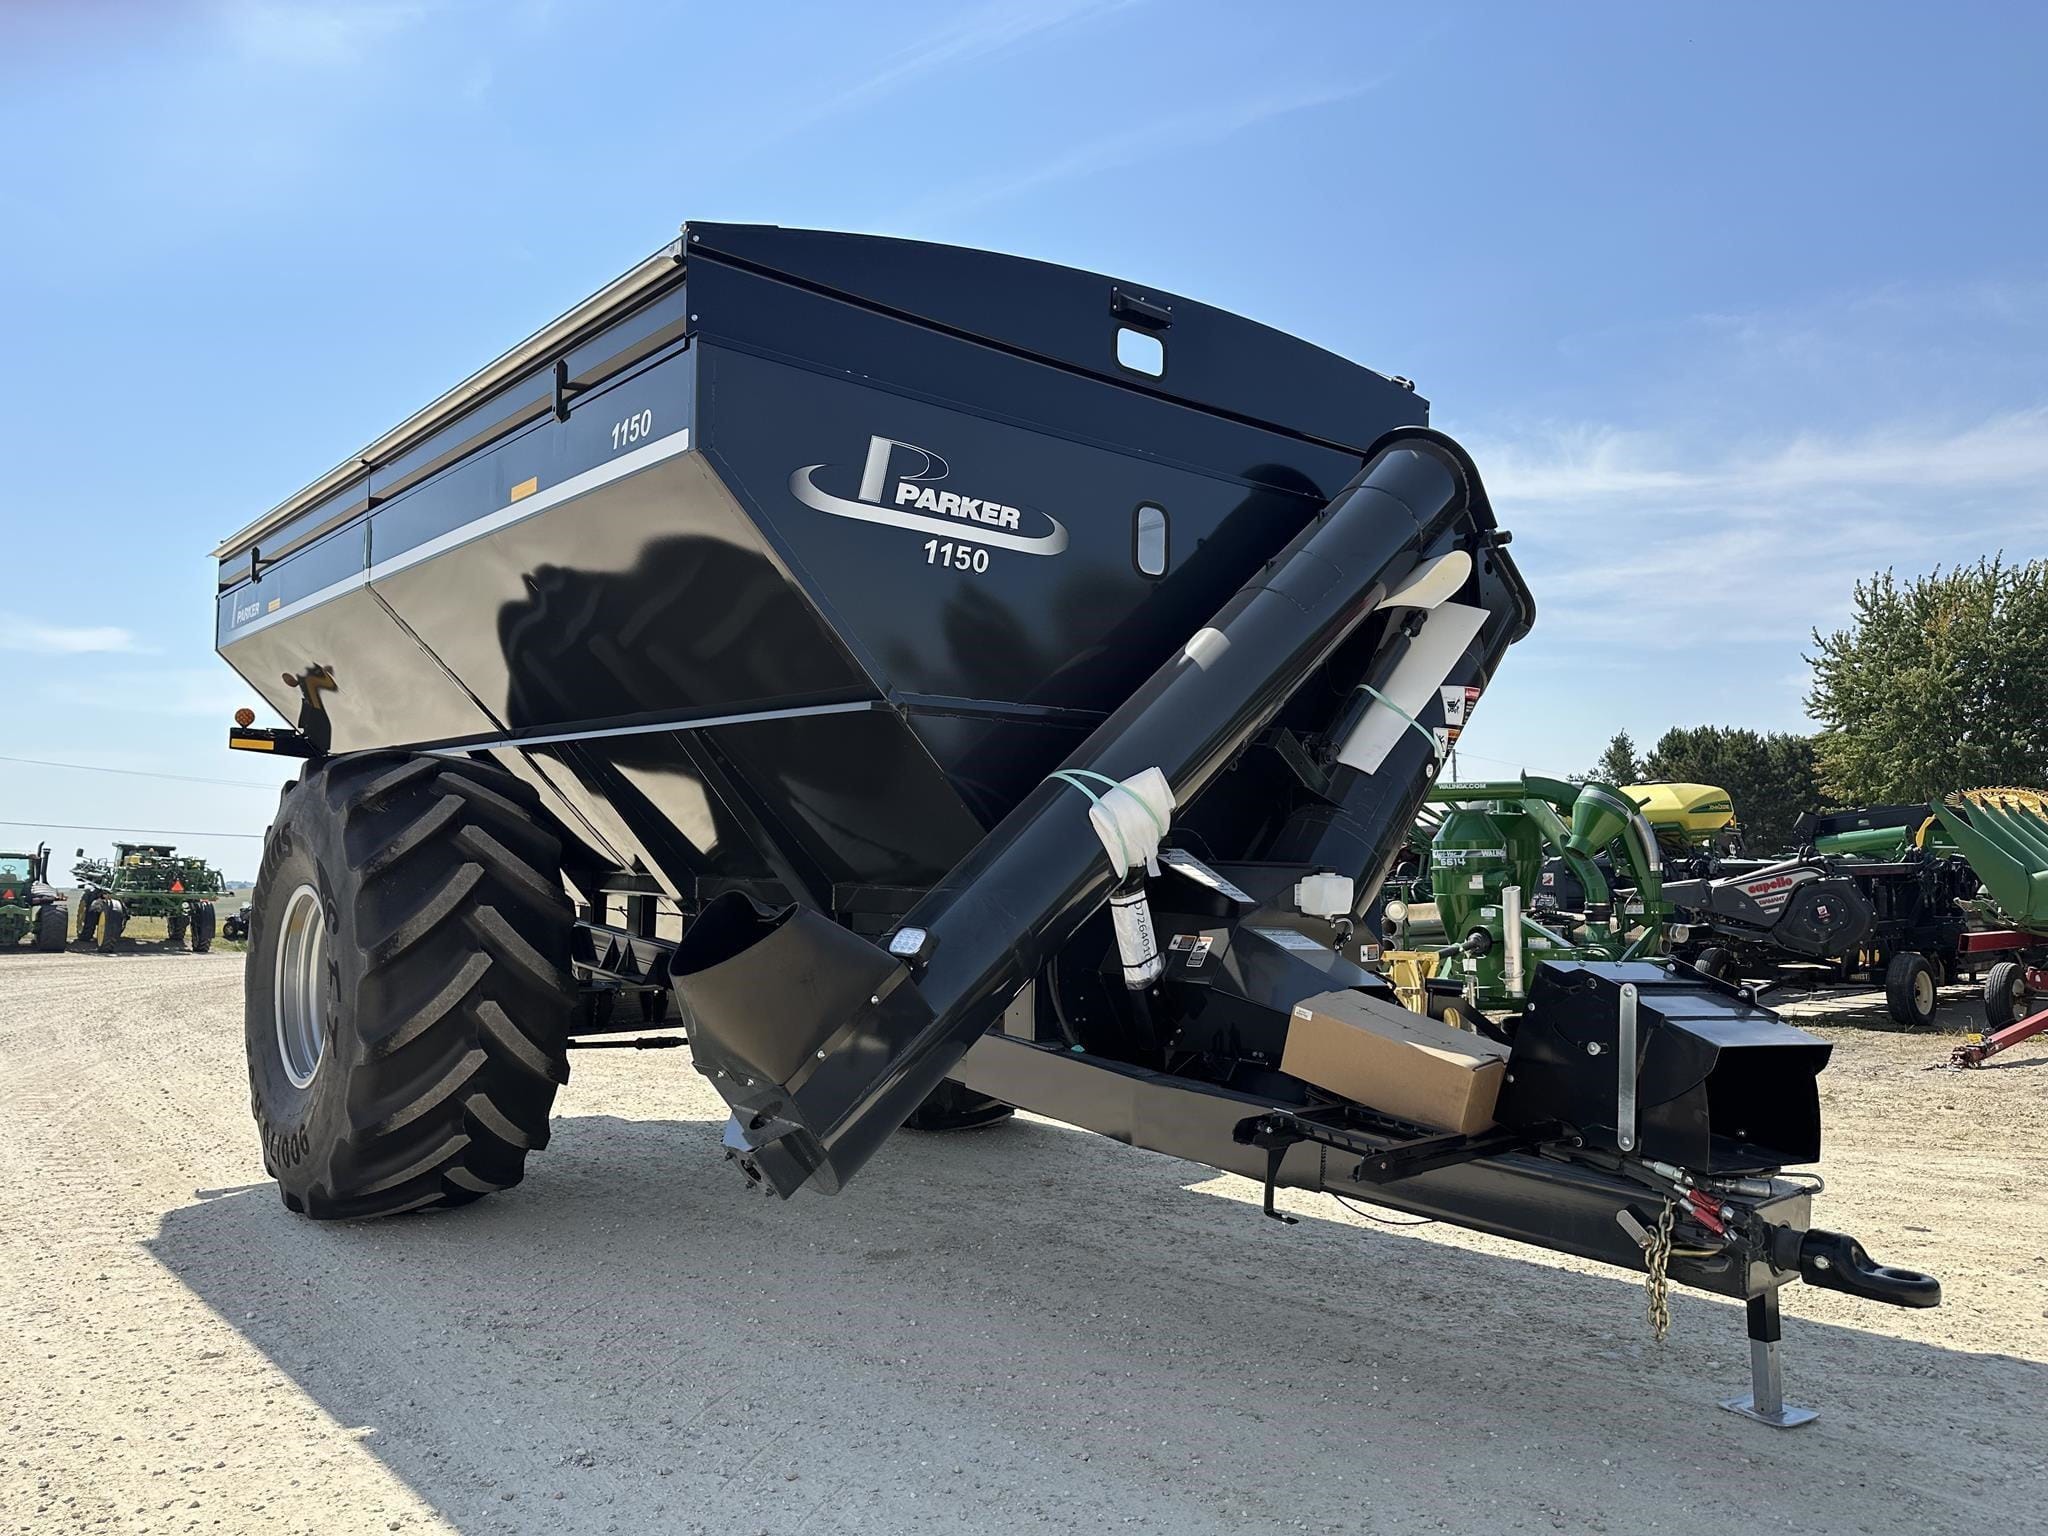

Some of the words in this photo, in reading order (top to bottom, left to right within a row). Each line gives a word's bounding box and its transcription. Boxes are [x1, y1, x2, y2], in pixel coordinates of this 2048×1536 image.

[611, 408, 652, 450] 1150
[894, 481, 1022, 530] PARKER
[924, 539, 989, 573] 1150
[236, 601, 260, 625] PARKER
[1440, 858, 1466, 866] 6614
